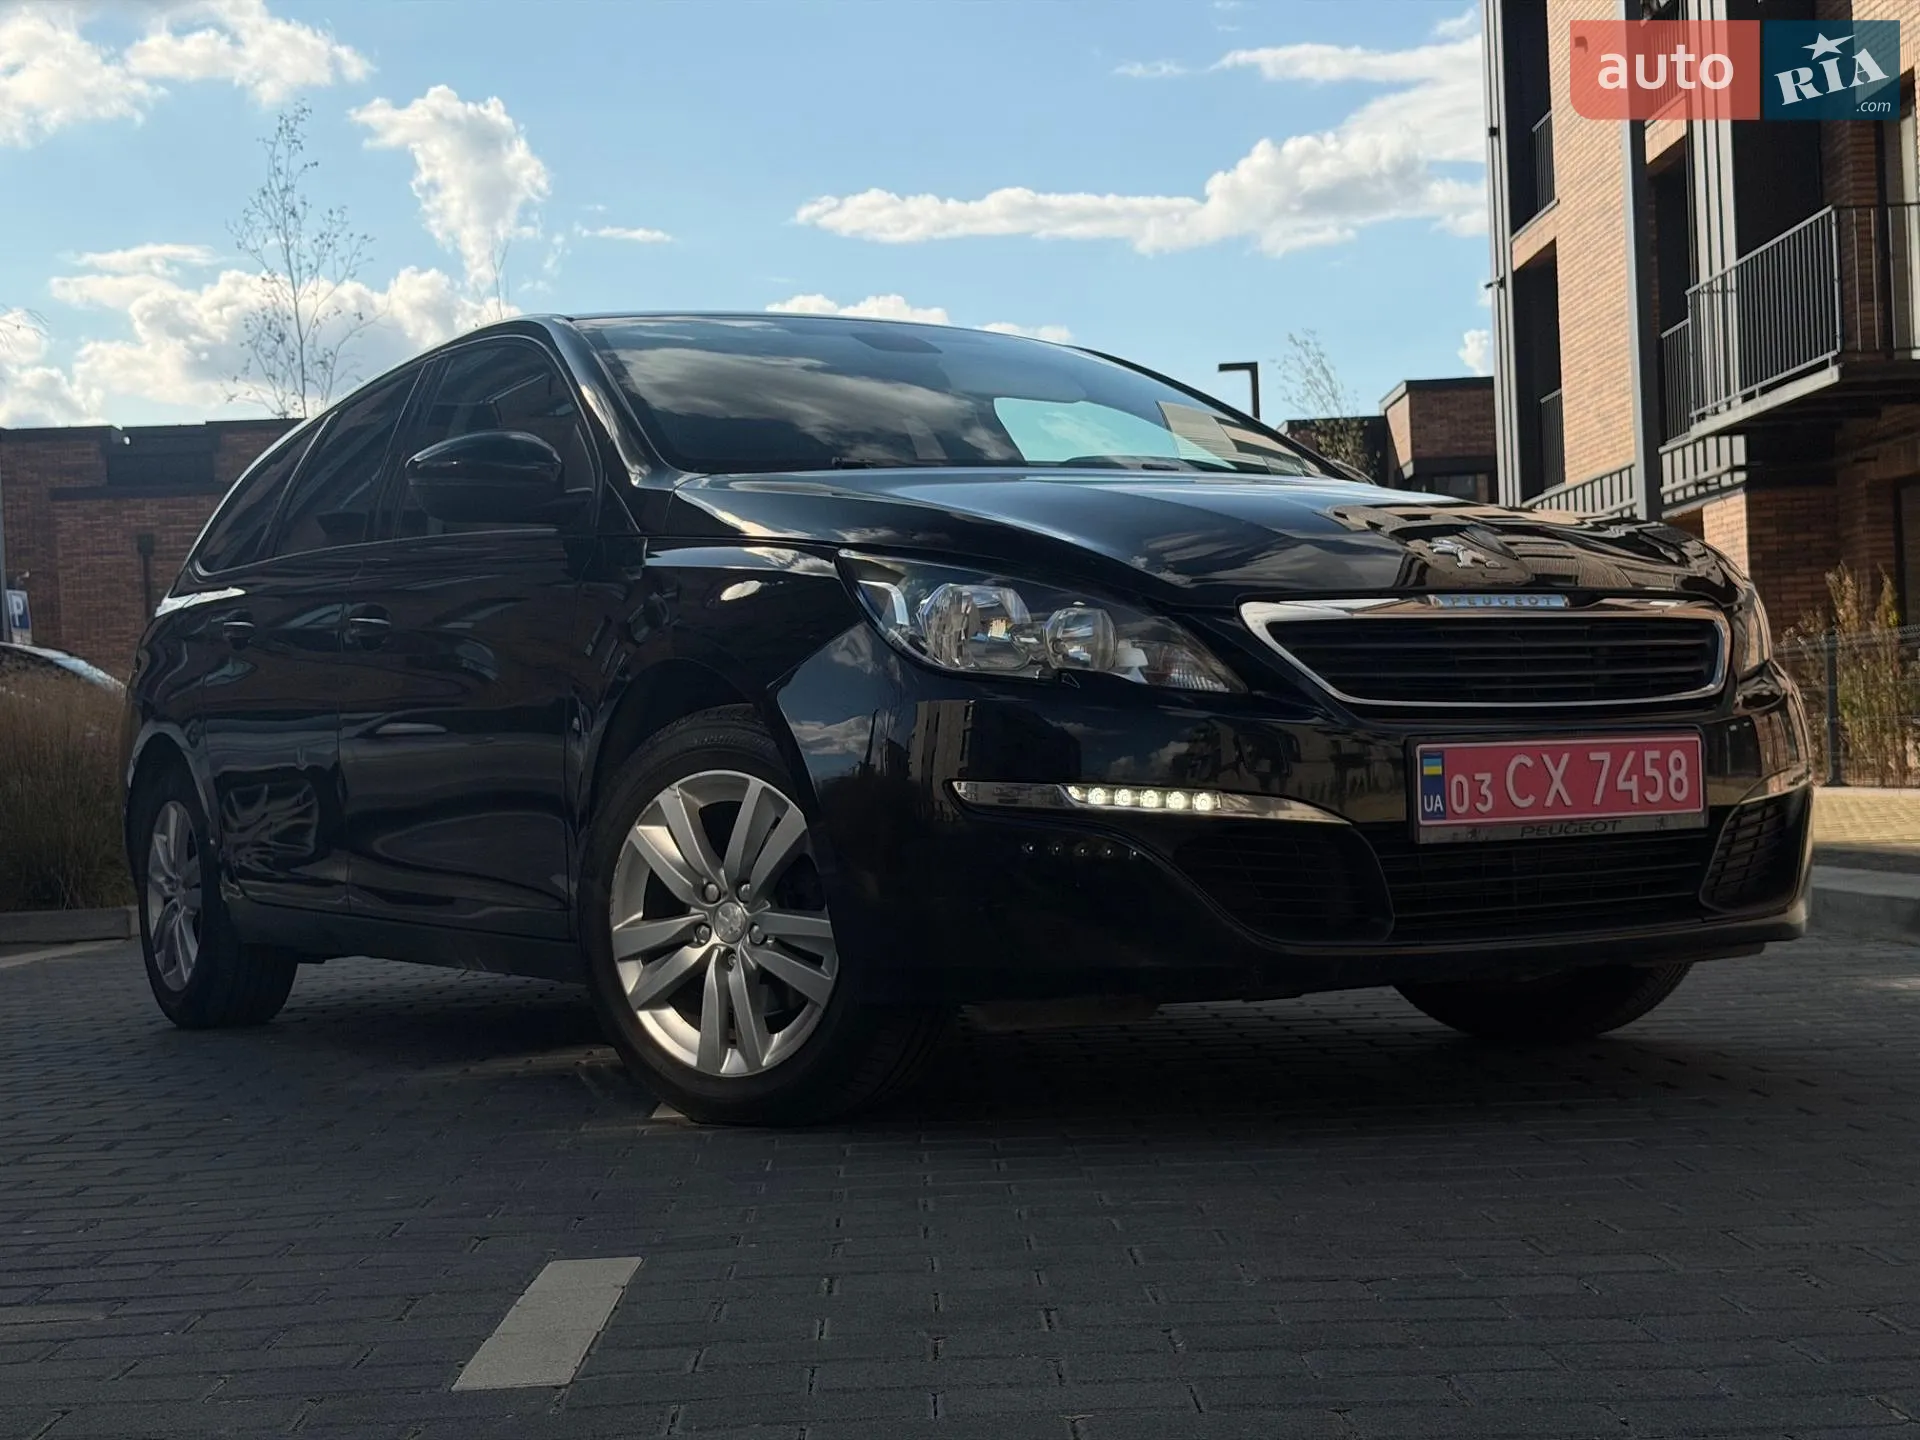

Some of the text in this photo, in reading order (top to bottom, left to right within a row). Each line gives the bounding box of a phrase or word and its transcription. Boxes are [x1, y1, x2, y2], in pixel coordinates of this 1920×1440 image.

[11, 594, 24, 627] P
[1451, 595, 1552, 606] PEUGEOT
[1450, 749, 1690, 815] 03 CX 7458
[1424, 793, 1444, 813] UA
[1520, 819, 1621, 838] PEUGEOT
